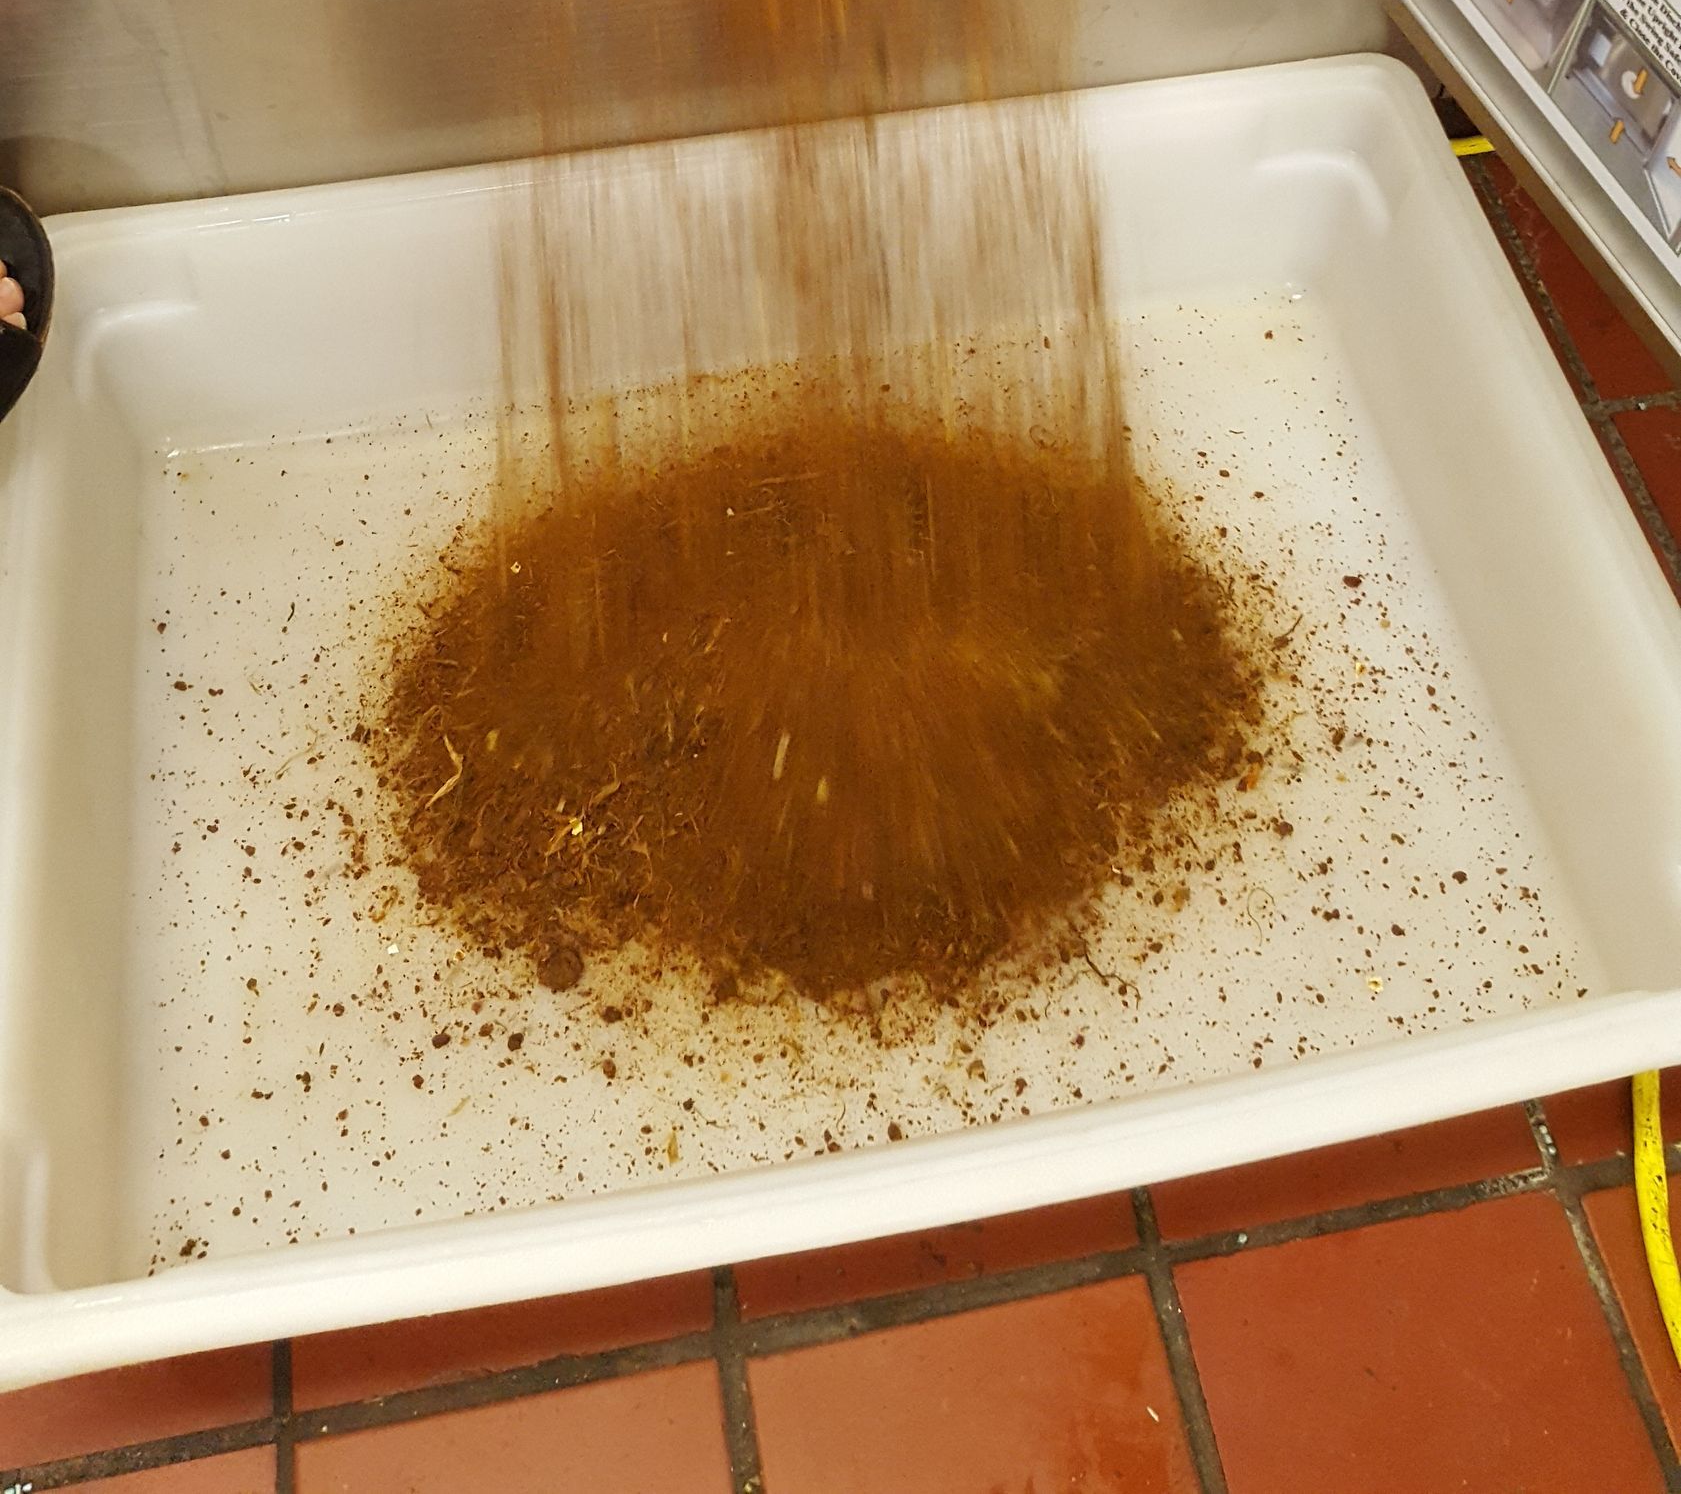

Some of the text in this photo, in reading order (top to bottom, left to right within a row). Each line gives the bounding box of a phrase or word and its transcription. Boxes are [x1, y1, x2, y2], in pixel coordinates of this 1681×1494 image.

[1639, 12, 1664, 46] Swing
[1646, 5, 1678, 46] Upright
[1627, 16, 1651, 46] Close
[1650, 42, 1664, 62] the
[1664, 58, 1681, 84] Cov
